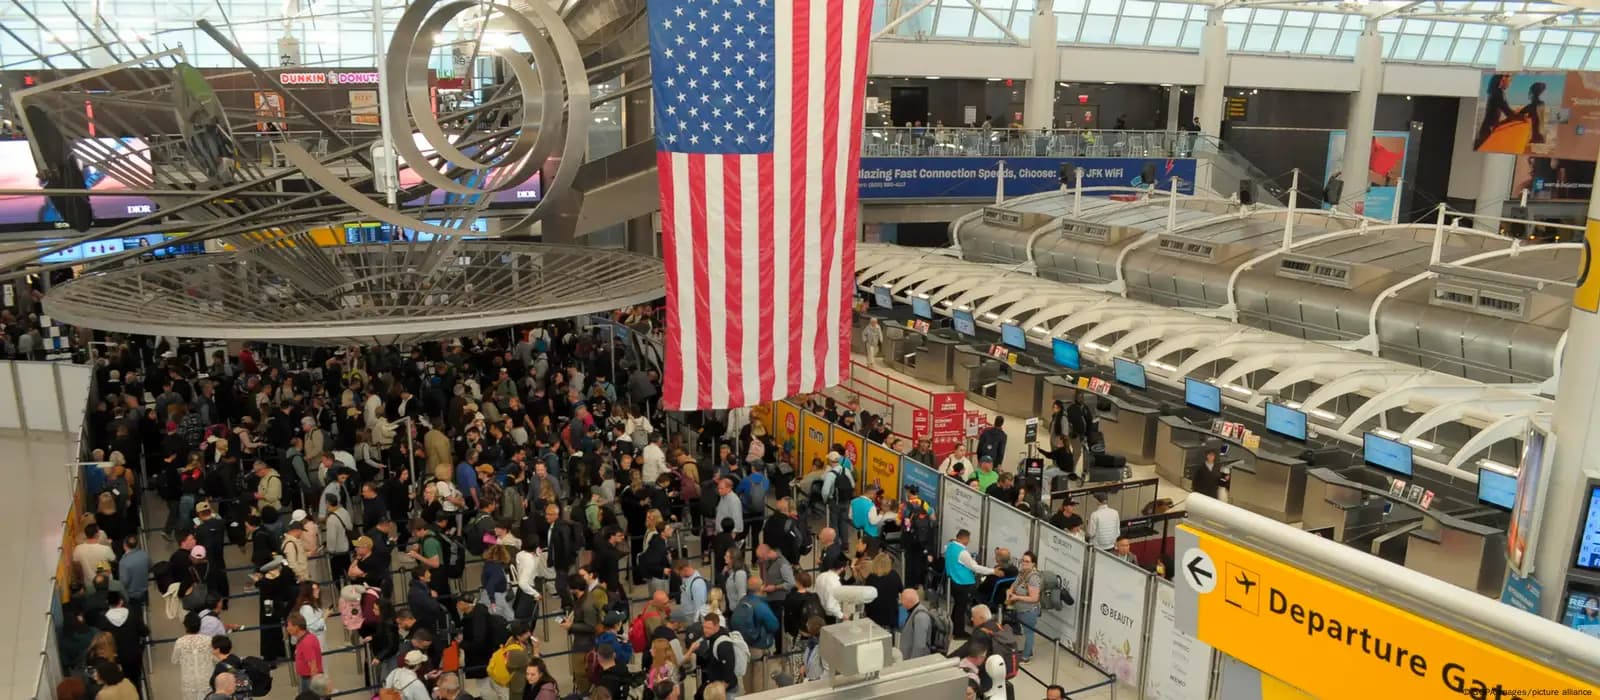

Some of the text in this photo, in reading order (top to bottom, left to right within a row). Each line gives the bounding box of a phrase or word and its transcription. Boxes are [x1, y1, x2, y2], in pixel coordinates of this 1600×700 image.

[280, 73, 326, 84] DUNKIN
[859, 168, 893, 181] lazing
[895, 168, 917, 178] Fast
[919, 168, 976, 178] Connection
[1019, 168, 1057, 178] Choose:
[1086, 168, 1103, 178] JFK
[1105, 168, 1124, 178] WiFi
[128, 205, 151, 214] DIOR
[1109, 607, 1134, 629] BEAUTY
[1269, 587, 1524, 700] Departure Gat
